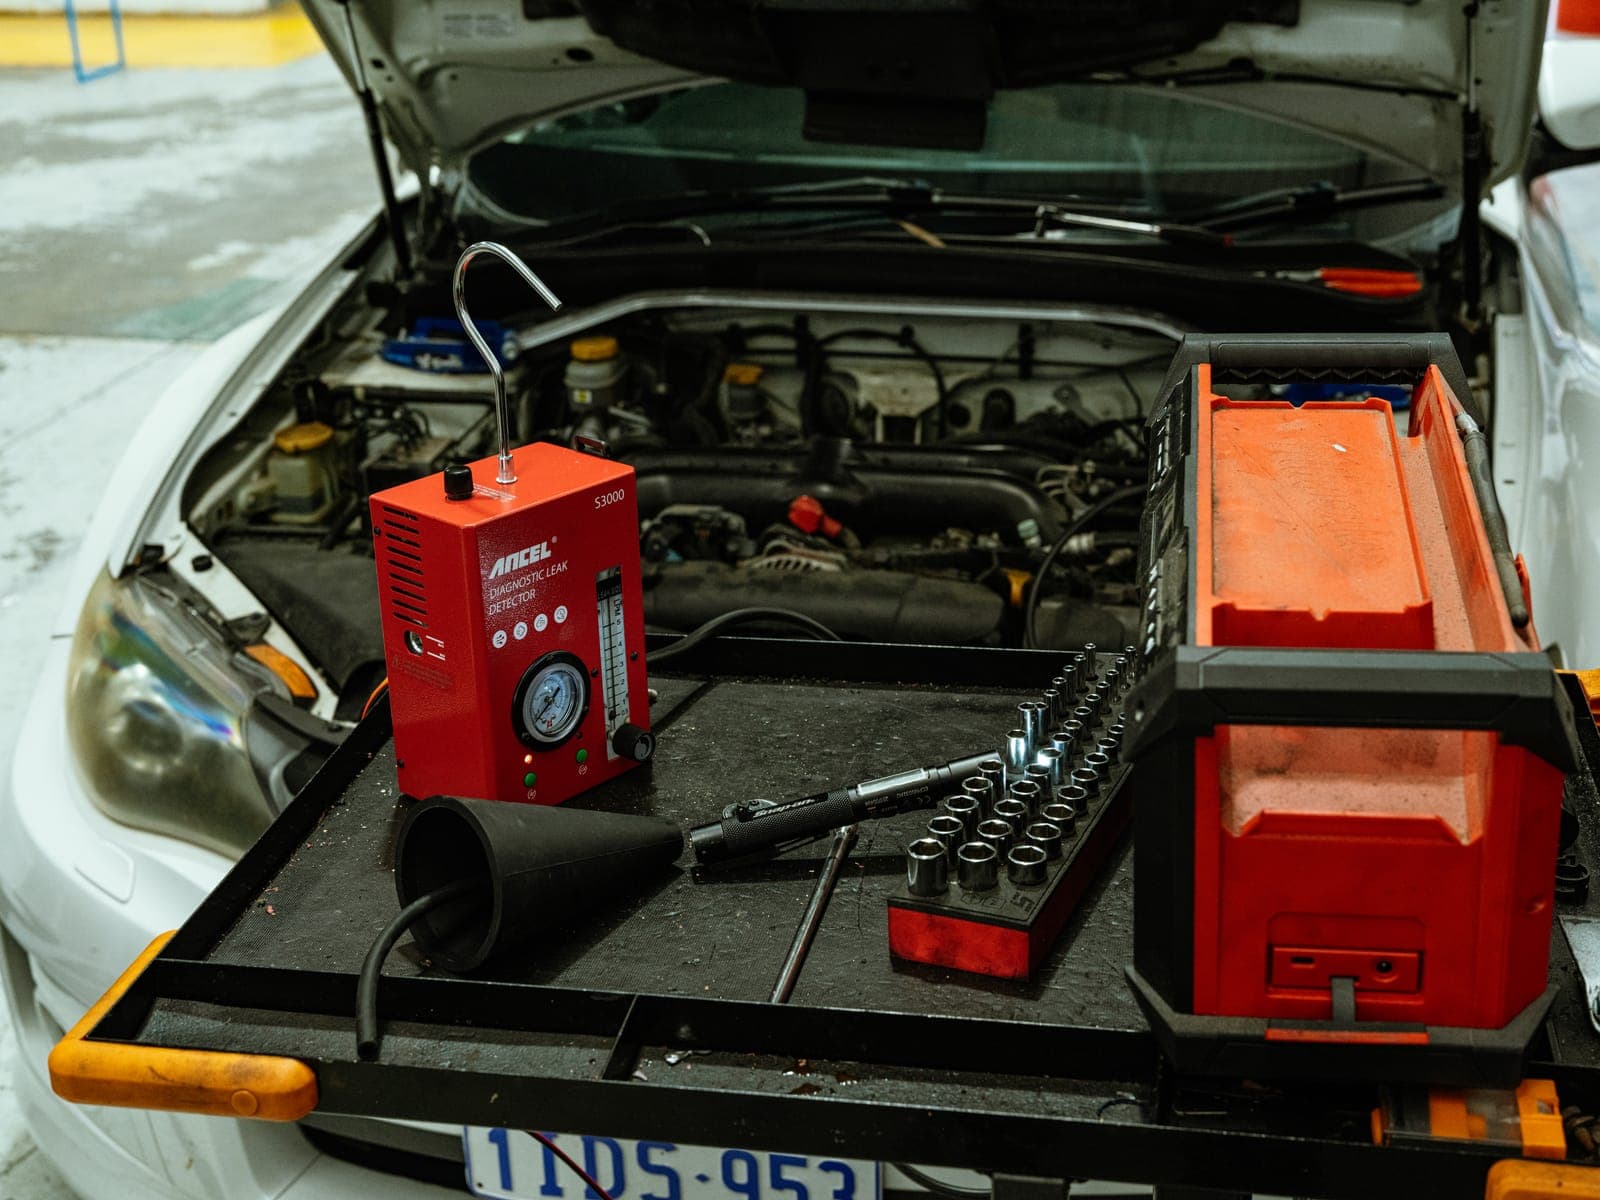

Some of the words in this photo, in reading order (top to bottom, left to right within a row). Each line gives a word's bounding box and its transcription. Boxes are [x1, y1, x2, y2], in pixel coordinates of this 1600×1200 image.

[594, 488, 625, 509] S3000
[488, 541, 552, 580] ANCEL
[489, 568, 544, 599] DIAGNOSTIC
[546, 560, 568, 577] LEAK
[488, 588, 536, 615] DETECTOR
